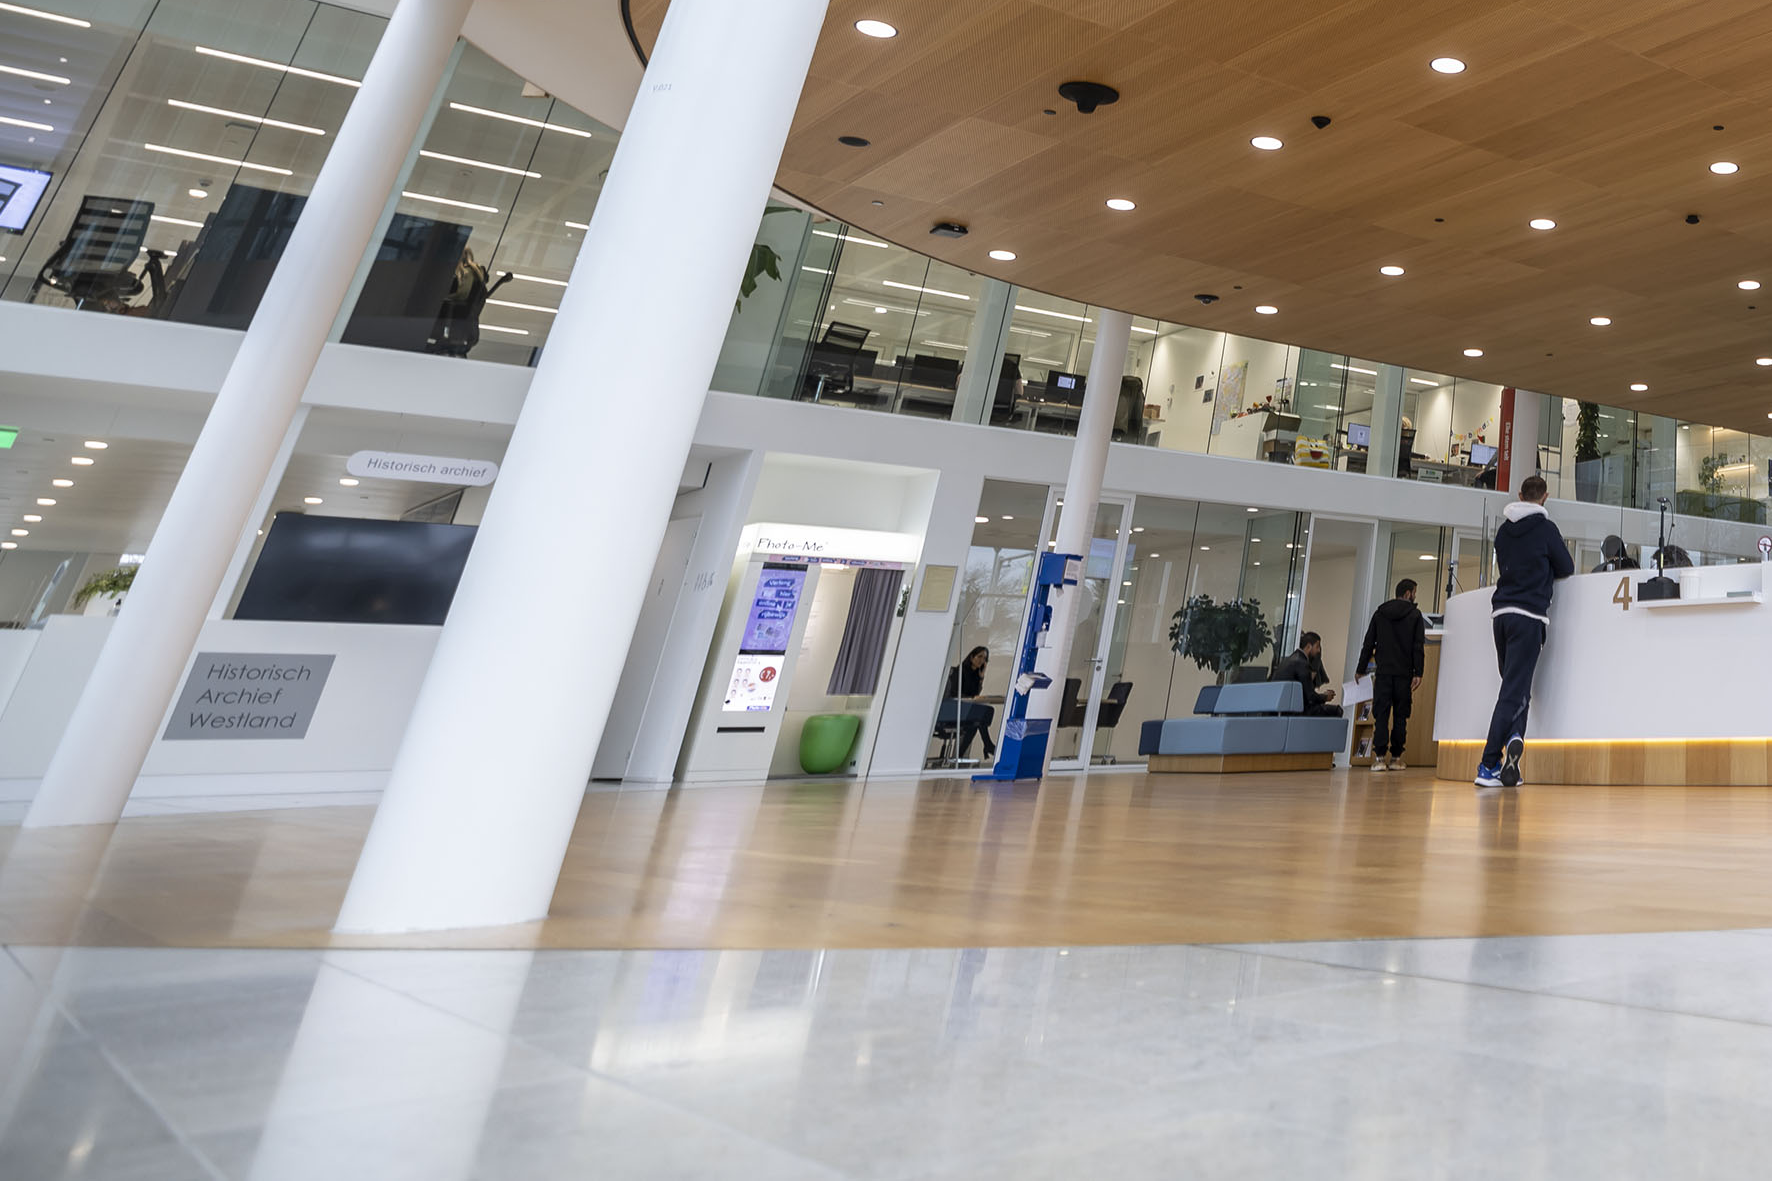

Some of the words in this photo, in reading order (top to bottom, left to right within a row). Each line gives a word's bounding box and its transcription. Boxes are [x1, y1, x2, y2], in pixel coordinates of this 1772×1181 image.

[367, 457, 436, 474] Historisch
[440, 465, 487, 478] archief
[1612, 576, 1633, 611] 4
[207, 663, 312, 681] Historisch
[196, 688, 284, 705] Archief
[189, 712, 297, 729] Westland
